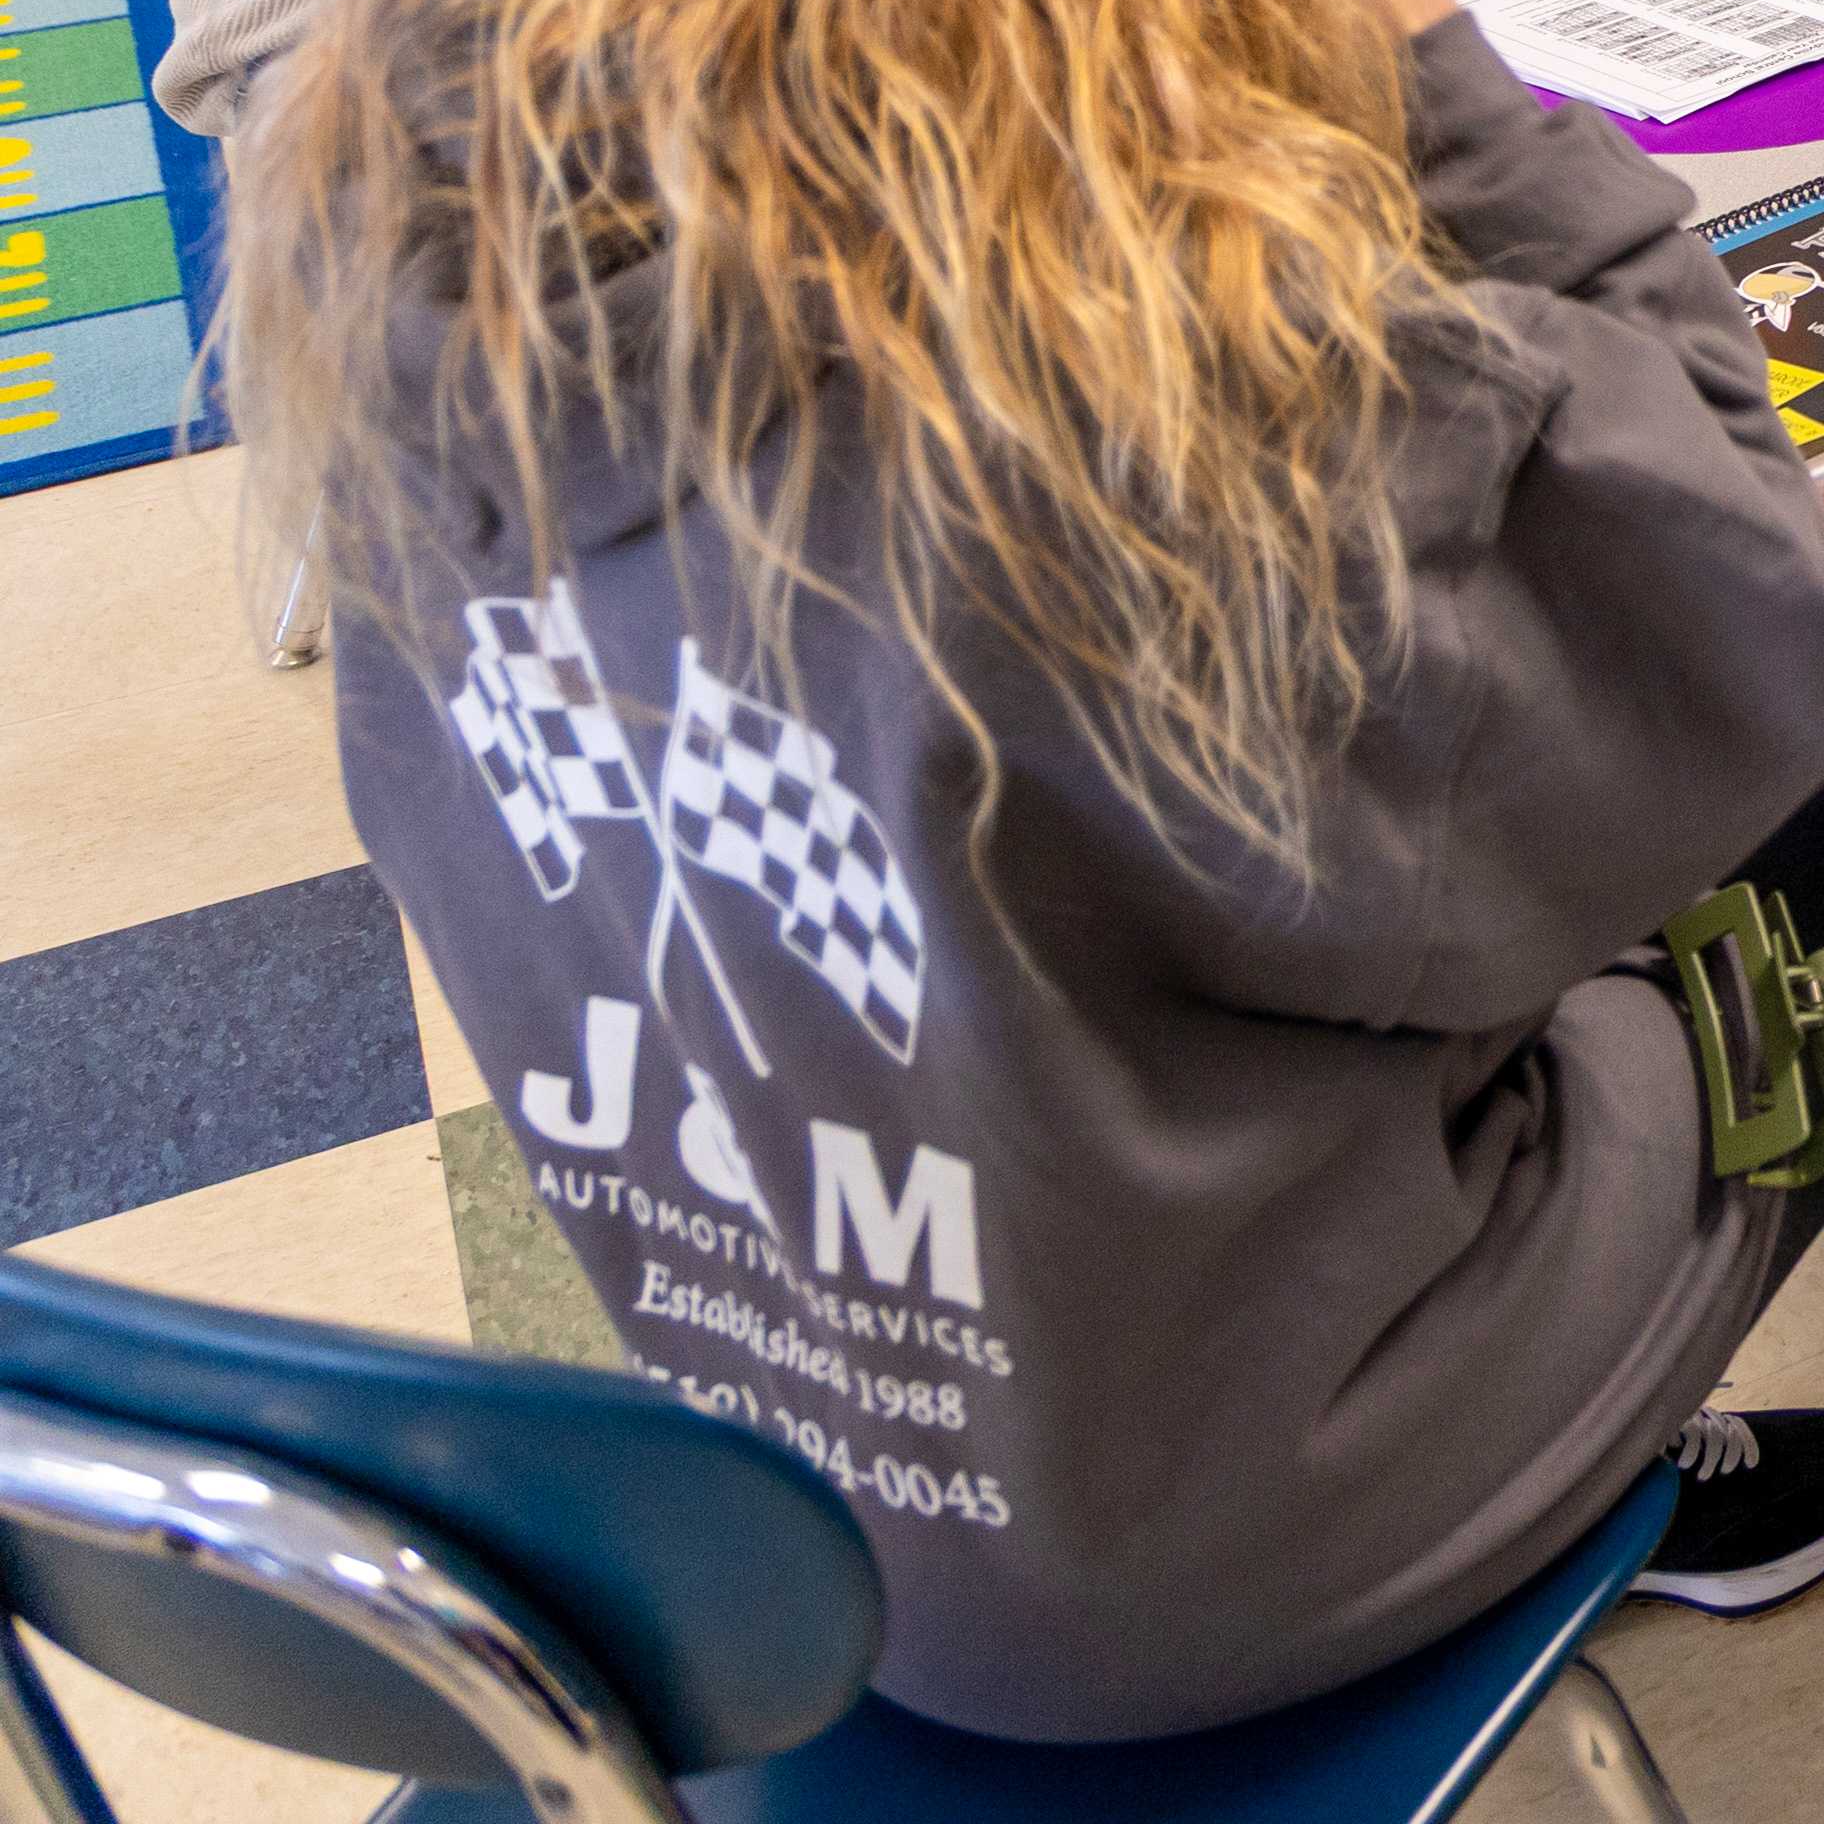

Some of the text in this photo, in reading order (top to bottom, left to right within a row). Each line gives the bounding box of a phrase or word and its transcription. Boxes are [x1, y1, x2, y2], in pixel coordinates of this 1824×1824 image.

[521, 995, 641, 1151] J
[810, 1118, 984, 1311] M
[633, 1259, 851, 1396] Established
[858, 1369, 967, 1433] 1988
[799, 1279, 1014, 1378] SERVICES
